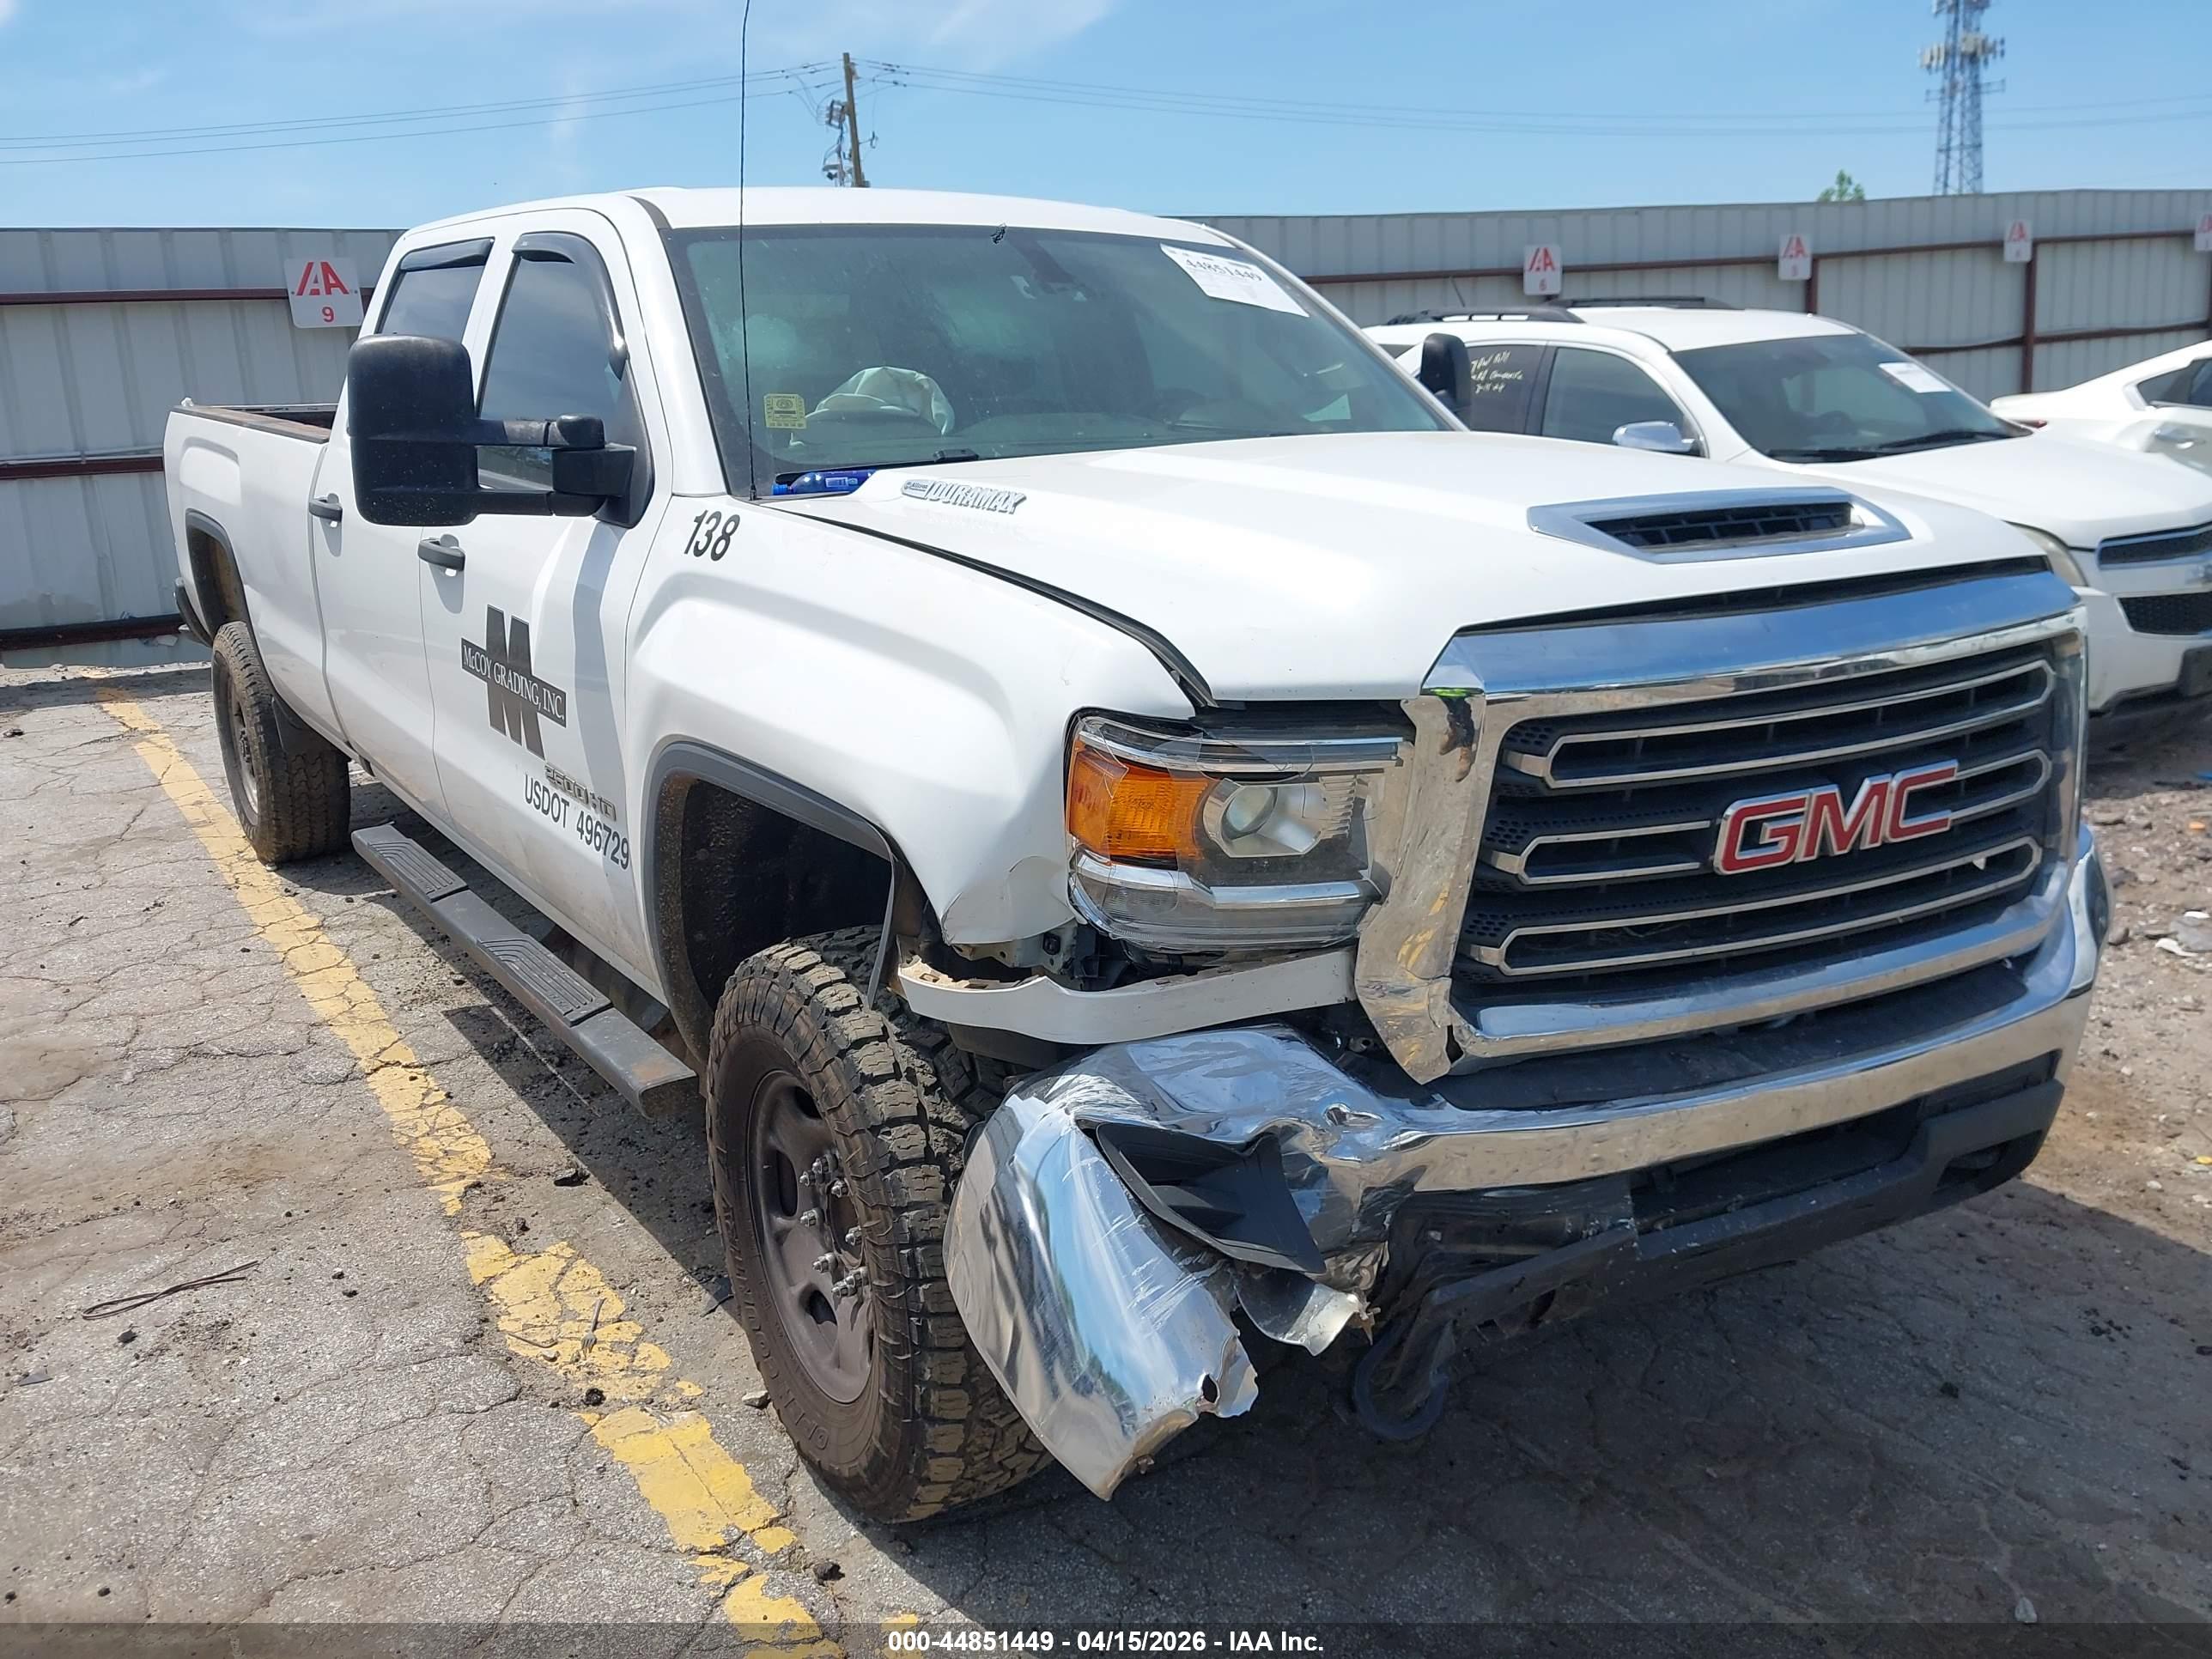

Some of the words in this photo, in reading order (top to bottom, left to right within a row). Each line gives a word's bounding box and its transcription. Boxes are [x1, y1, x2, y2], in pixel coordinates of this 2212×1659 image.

[321, 306, 335, 323] 9
[928, 481, 1027, 515] DURAMAX
[684, 509, 741, 562] 138
[462, 644, 493, 679] McCOY
[493, 662, 542, 712] GRADING,
[542, 687, 566, 721] INC.
[525, 773, 570, 829] USDOT
[576, 810, 629, 870] 496729
[1712, 758, 1959, 876] GMC
